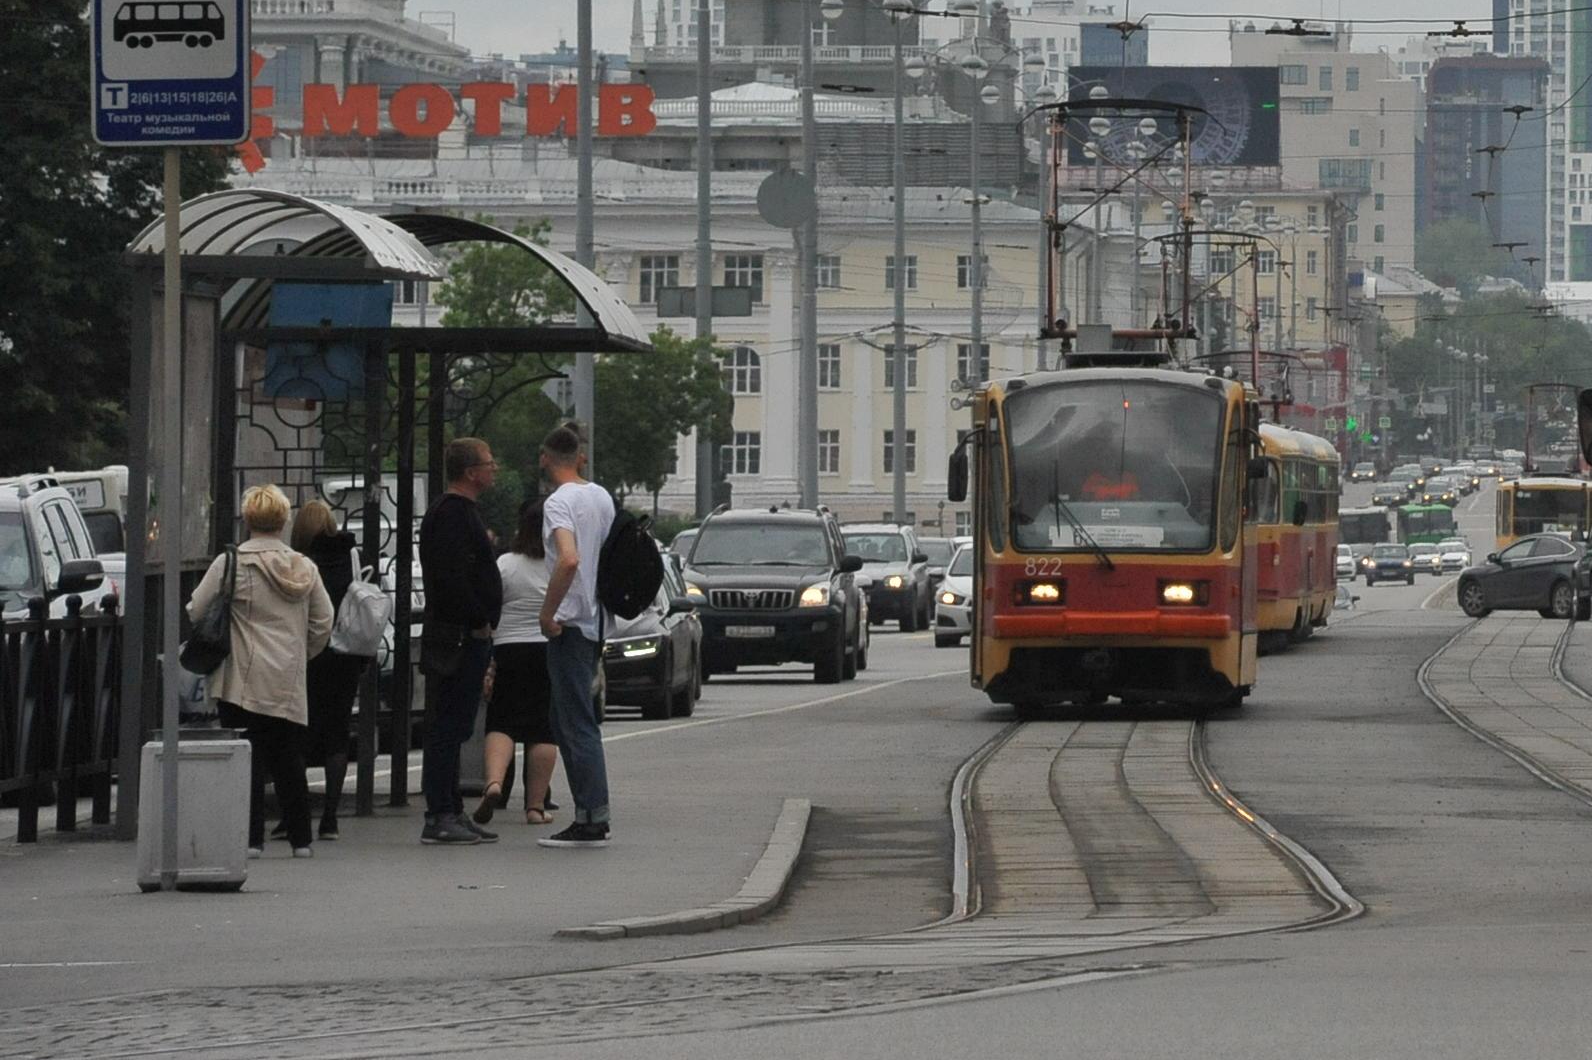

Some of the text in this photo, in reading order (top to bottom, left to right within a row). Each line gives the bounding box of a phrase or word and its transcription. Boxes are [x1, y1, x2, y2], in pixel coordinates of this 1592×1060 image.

[303, 83, 657, 136] МОТИВ
[106, 112, 230, 124] Театр музыкальной
[141, 126, 195, 135] комедии
[1024, 556, 1062, 576] 822
